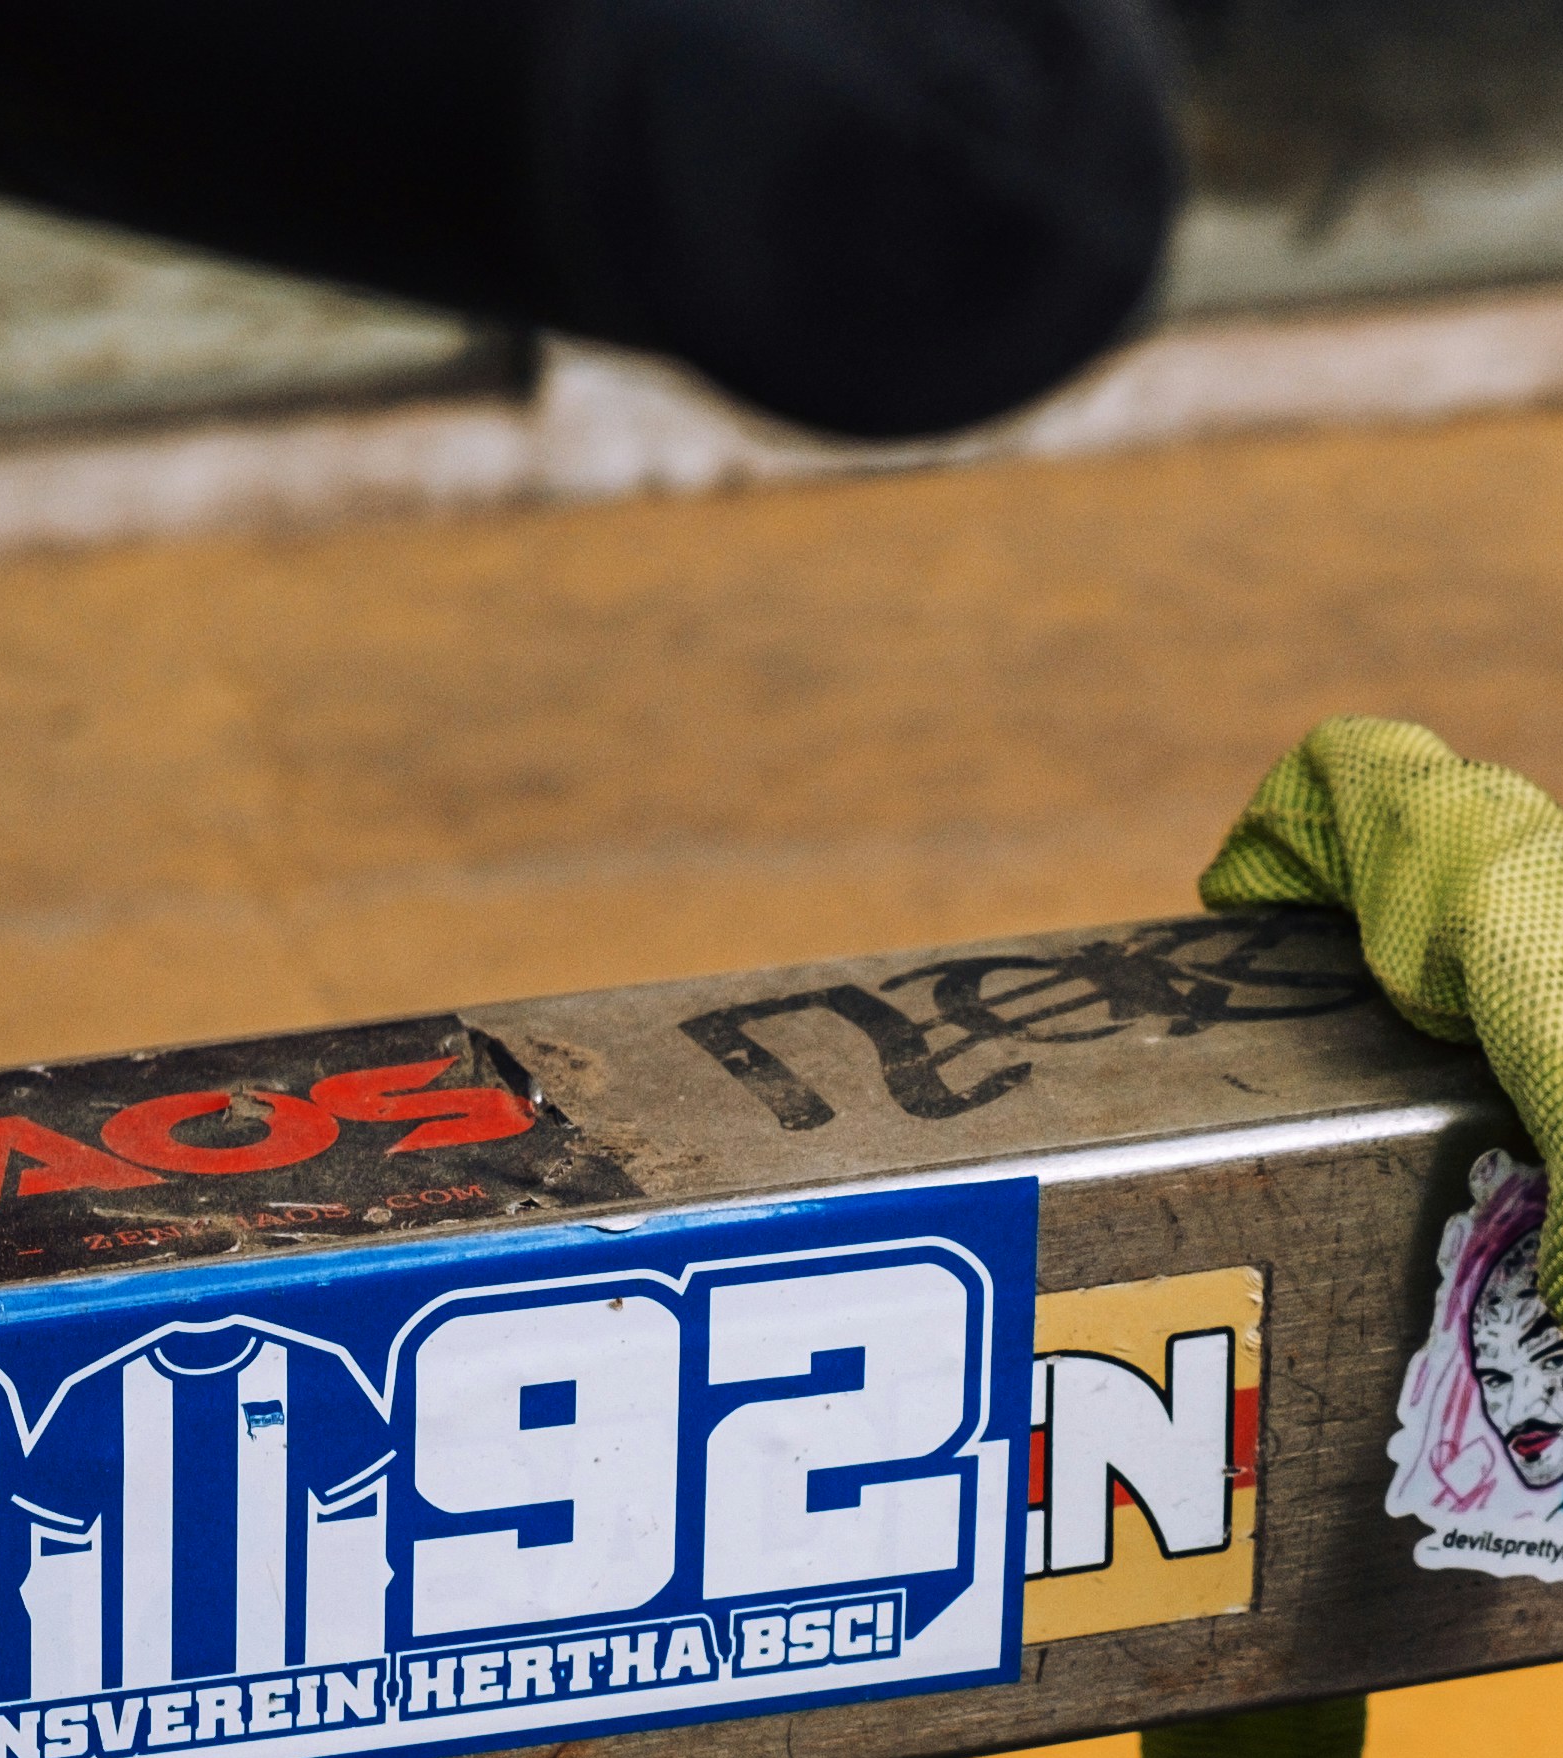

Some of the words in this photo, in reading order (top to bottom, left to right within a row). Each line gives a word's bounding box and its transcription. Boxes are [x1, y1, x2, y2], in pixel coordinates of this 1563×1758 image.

[1023, 1326, 1236, 1583] N
[406, 1613, 716, 1716] HERTHA
[740, 1601, 897, 1668] BSC!
